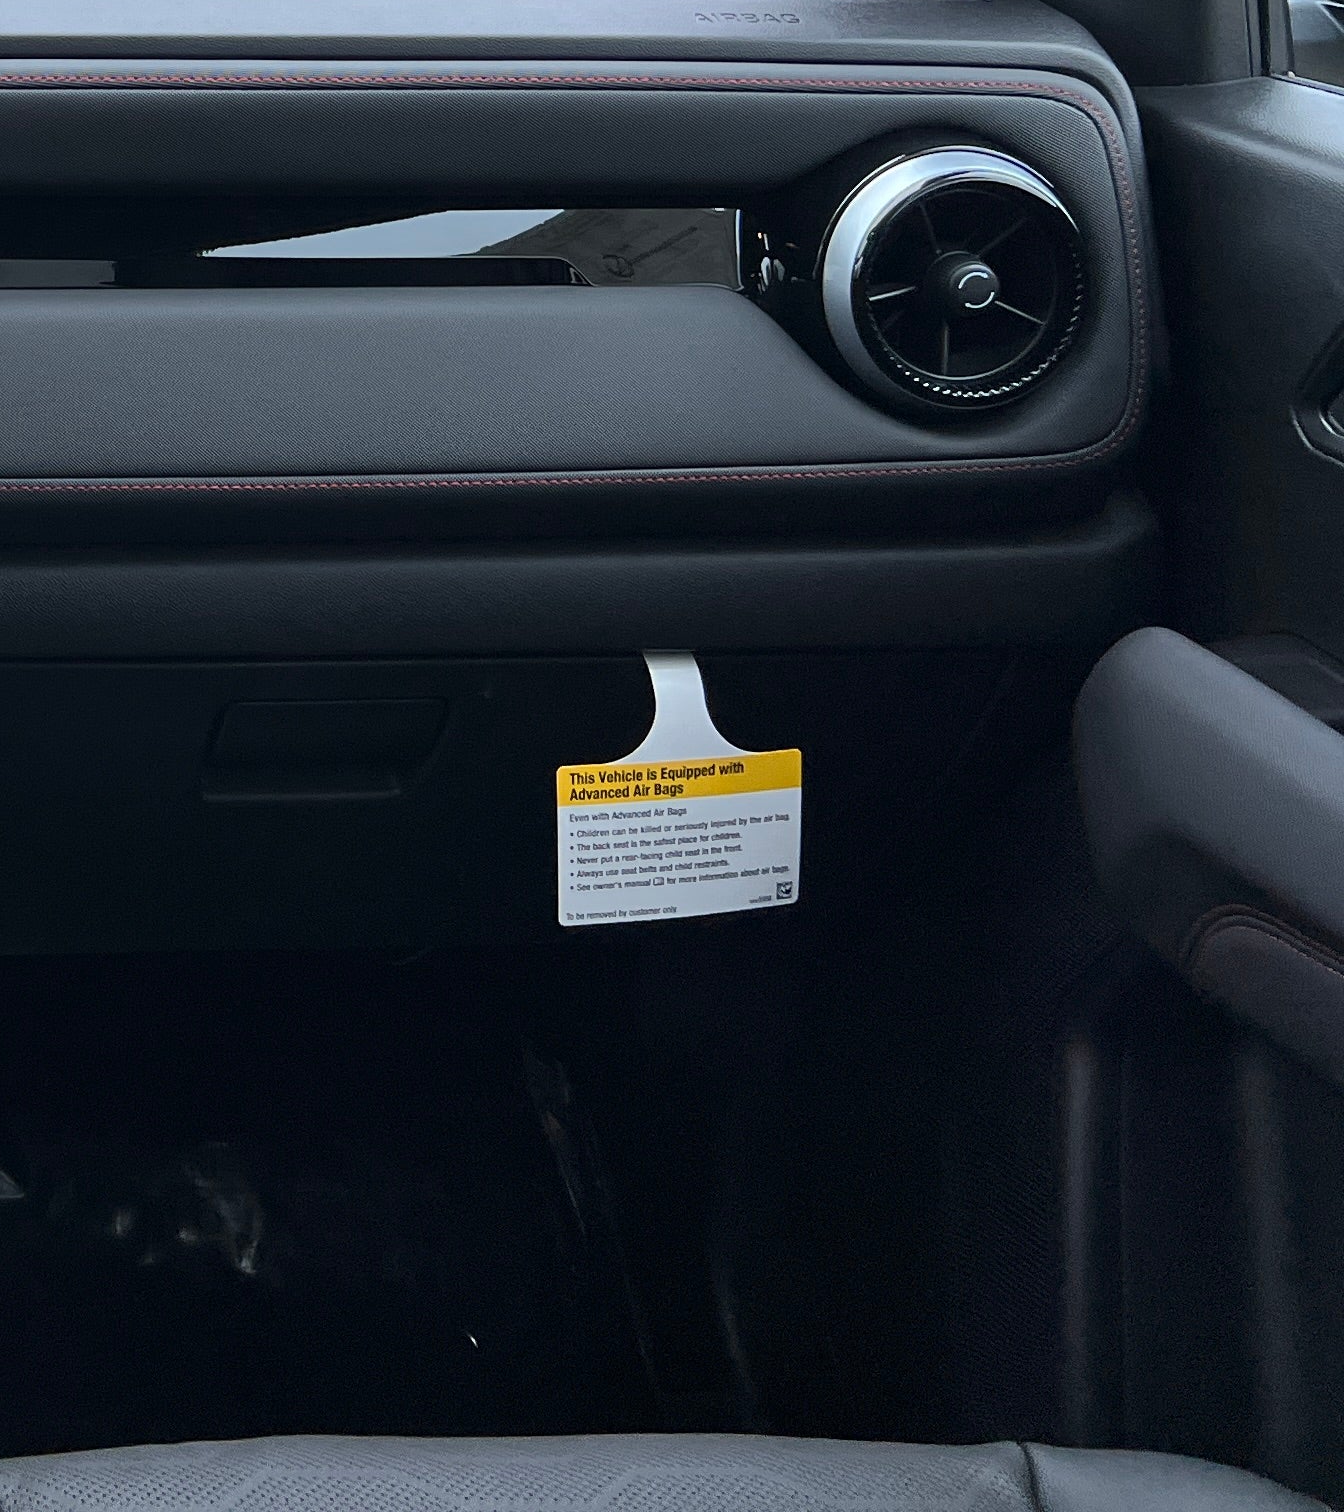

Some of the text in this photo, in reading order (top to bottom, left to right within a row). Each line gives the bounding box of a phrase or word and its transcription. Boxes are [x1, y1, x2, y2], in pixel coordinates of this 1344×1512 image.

[695, 12, 800, 24] AIRBAG
[569, 761, 744, 785] This Vehicle is Equipped with
[569, 782, 684, 801] Advanced Air Bags
[569, 807, 687, 823] Even with Advanced Air Bags
[566, 905, 677, 921] To be removed by customer only
